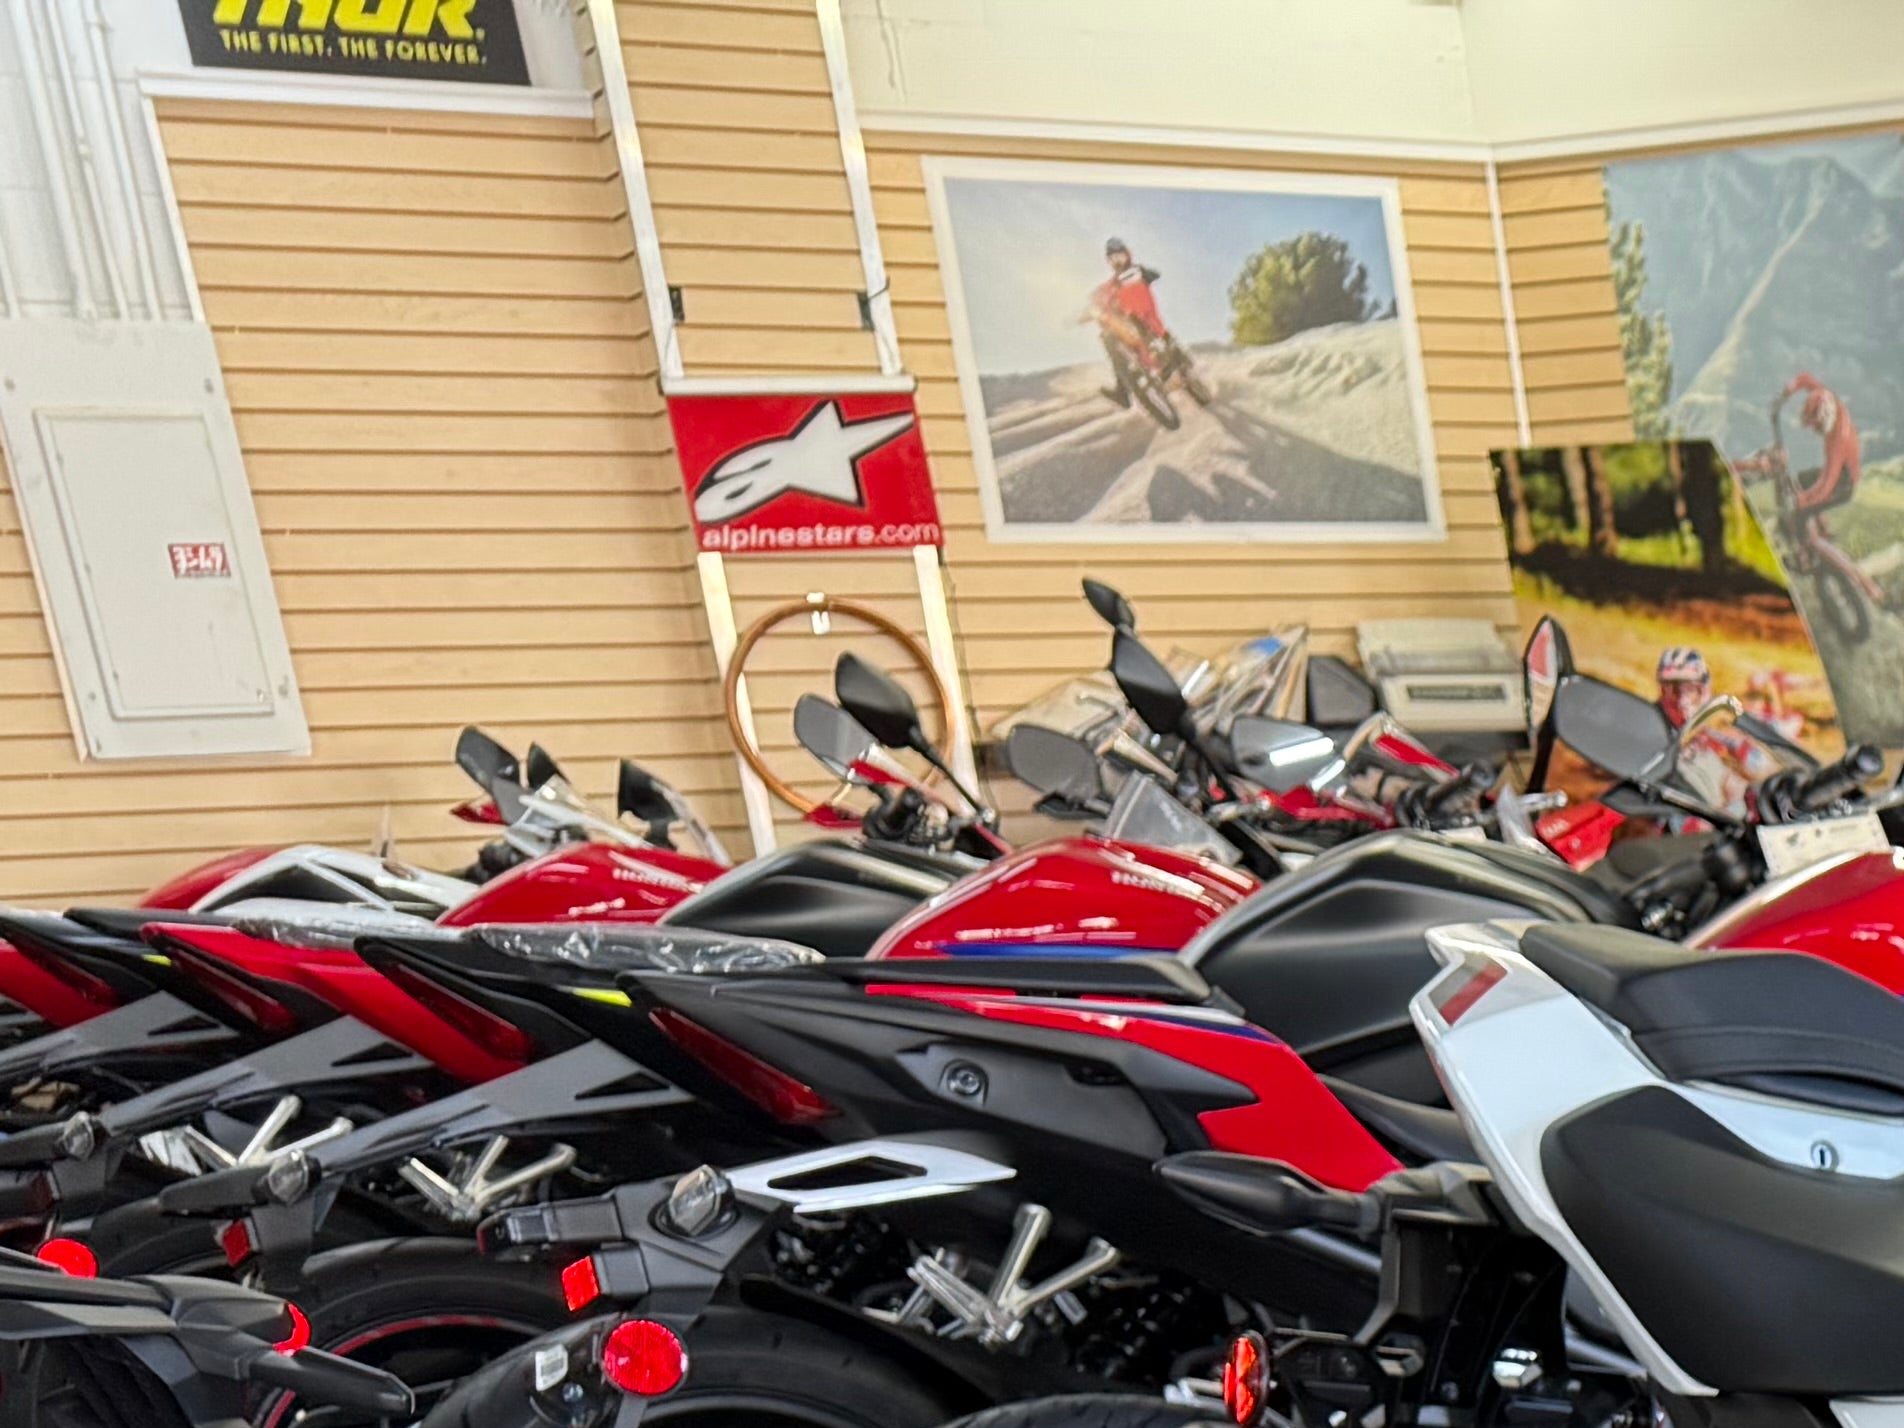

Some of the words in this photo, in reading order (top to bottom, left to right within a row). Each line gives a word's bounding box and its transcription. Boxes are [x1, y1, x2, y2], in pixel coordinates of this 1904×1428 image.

[220, 29, 262, 53] THE
[338, 36, 378, 60] THE
[702, 521, 940, 551] alpinestars.com
